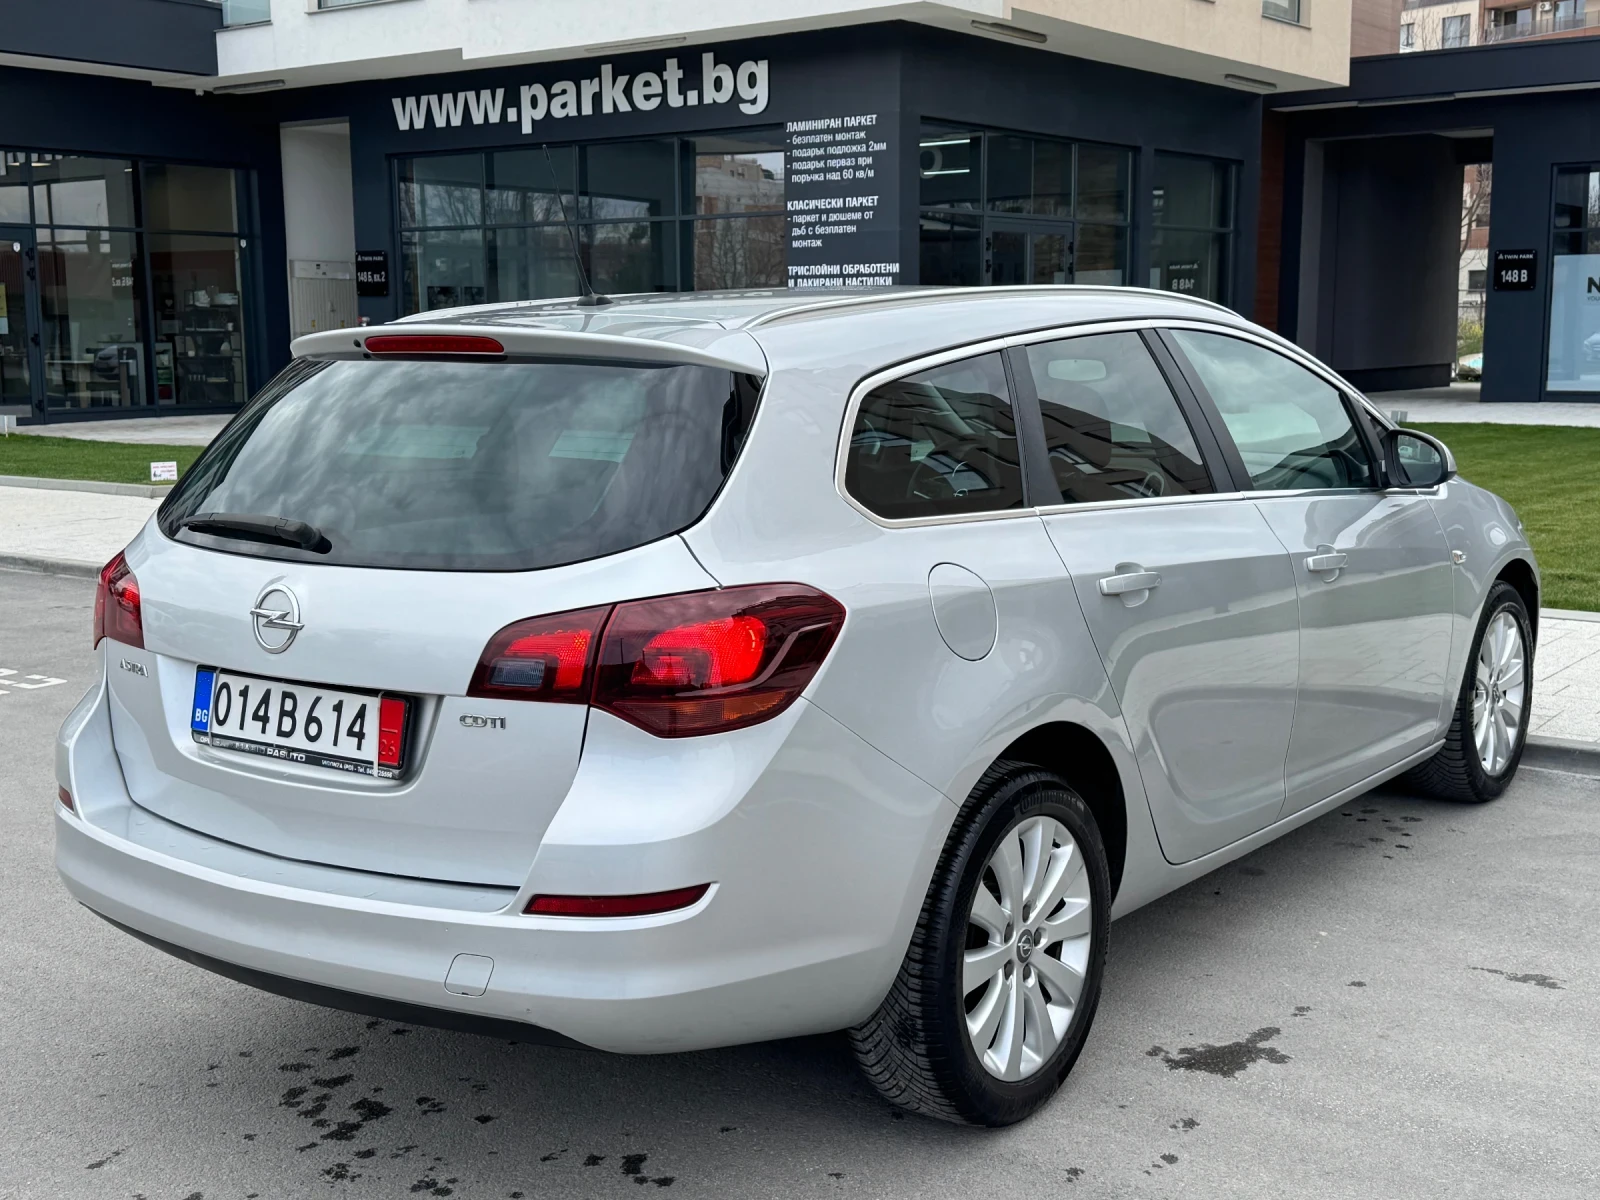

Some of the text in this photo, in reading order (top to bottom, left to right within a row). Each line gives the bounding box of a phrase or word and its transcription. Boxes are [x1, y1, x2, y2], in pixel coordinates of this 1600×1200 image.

[391, 51, 770, 135] www.parket.bg
[786, 114, 878, 132] ЛАМИНИРАН ПАРКЕТ
[792, 133, 834, 145] безплатен
[835, 129, 866, 141] монтаж
[792, 147, 825, 158] подарък
[826, 143, 867, 155] подложка
[868, 141, 887, 151] 2мм
[792, 159, 825, 170] подарък
[826, 157, 856, 169] перваз
[857, 155, 873, 167] при
[791, 167, 875, 184] поръчка над 60 кв/м
[787, 195, 879, 211] КЛАСИЧЕСКИ ПАРКЕТ
[792, 212, 820, 224] паркет
[821, 212, 827, 221] и
[828, 211, 862, 222] дюшеме
[863, 210, 874, 219] от
[791, 224, 857, 237] дъб с безплатен
[792, 238, 823, 248] монтаж
[787, 262, 900, 276] ТРИСЛОЙНИ ОБРАБОТЕНИ
[1500, 269, 1519, 283] 148
[788, 276, 893, 288] И ЛАКИРАНИ НАСТИЛКИ
[120, 658, 149, 678] ASTRA
[194, 708, 209, 723] BG
[214, 681, 368, 751] 014B614
[459, 713, 506, 730] CDTI
